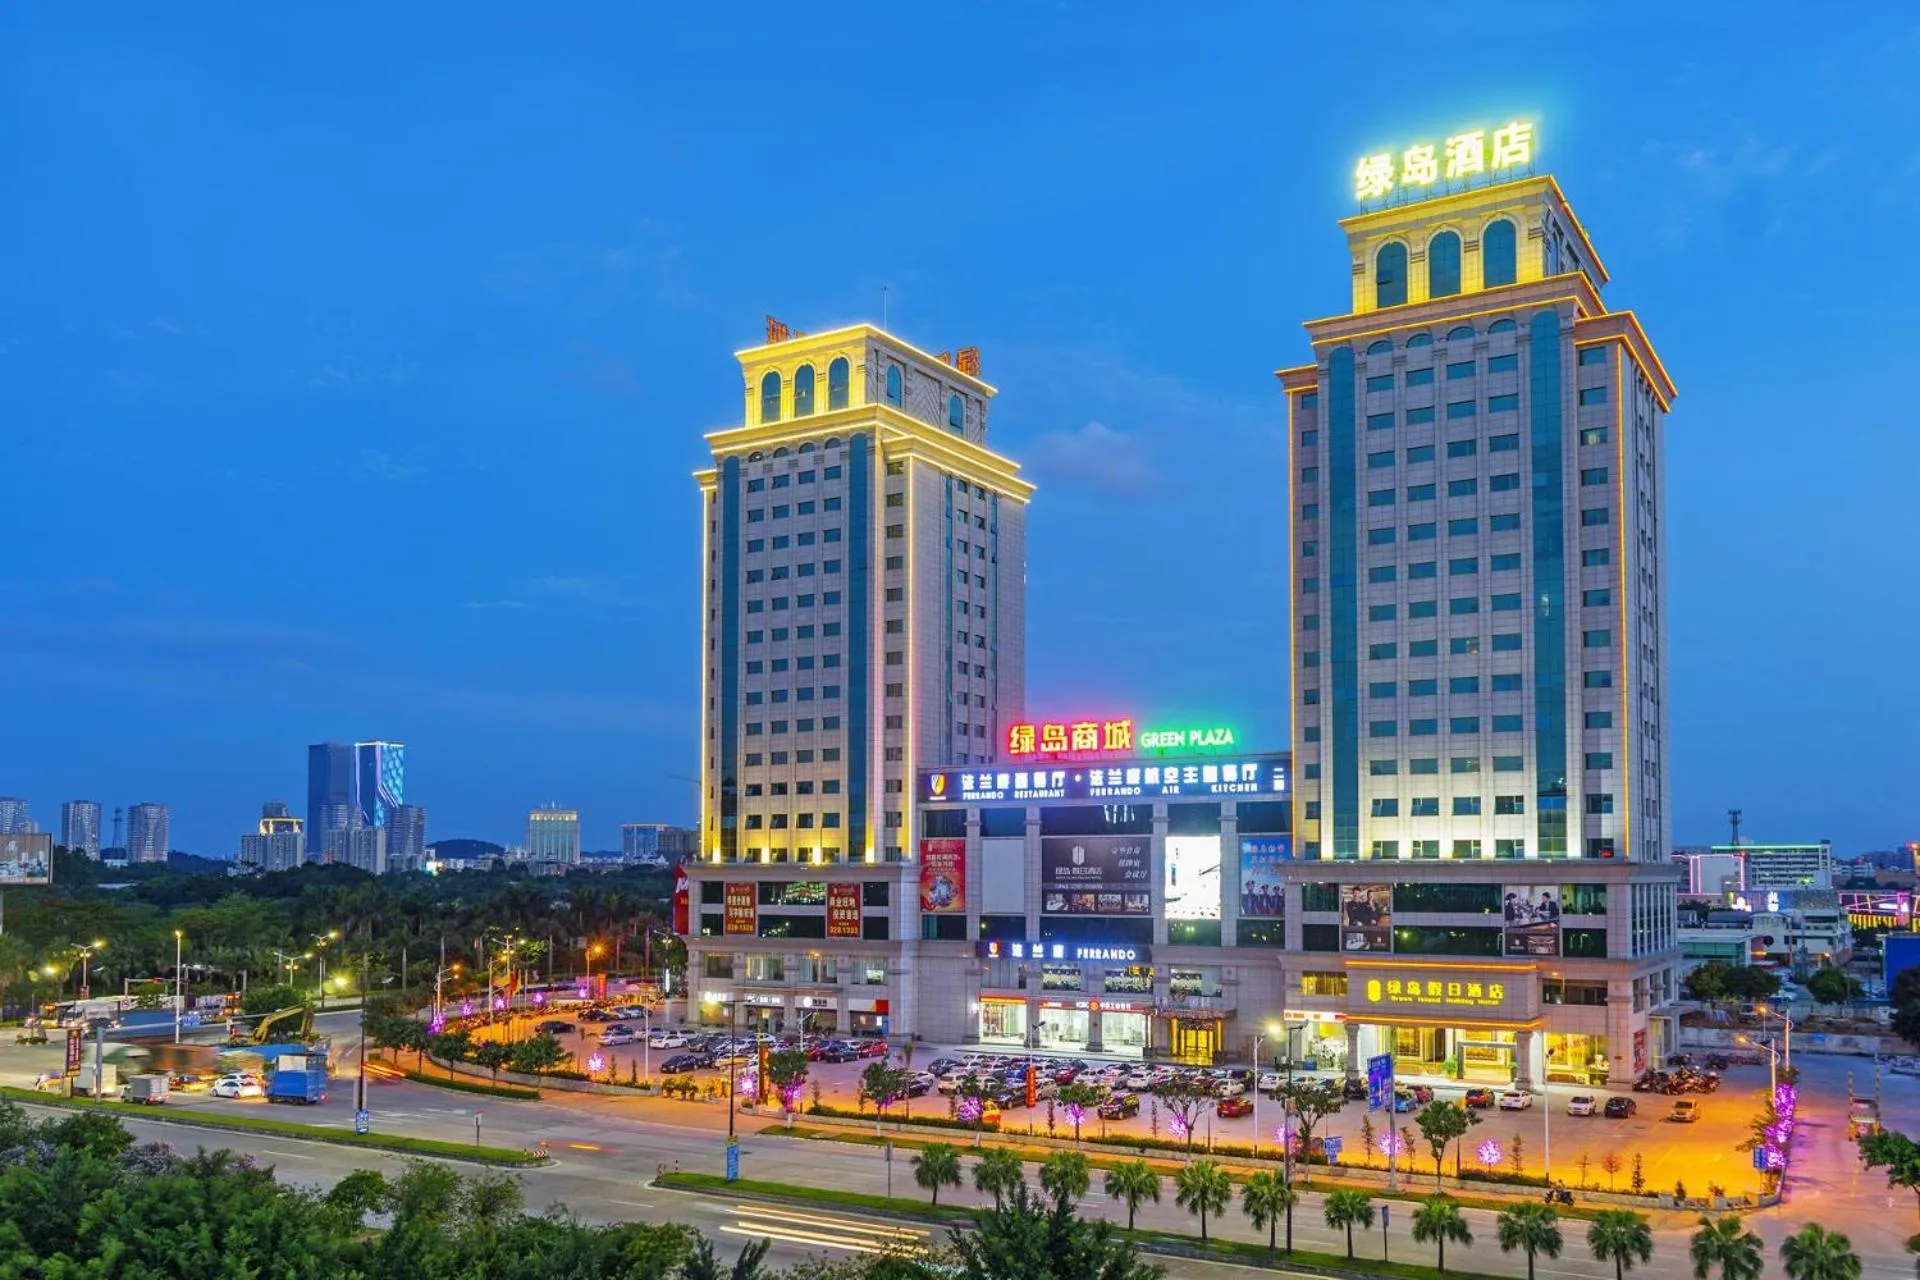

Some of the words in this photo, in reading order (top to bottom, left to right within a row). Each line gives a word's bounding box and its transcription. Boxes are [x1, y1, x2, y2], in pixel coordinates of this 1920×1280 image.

[1355, 122, 1533, 199] 绿岛酒店
[1008, 720, 1132, 754] 绿岛商城
[1140, 733, 1184, 748] GREEN
[1189, 728, 1233, 744] PLAZA
[1089, 786, 1142, 798] FERRANDO
[1161, 784, 1180, 795] AIR
[1210, 782, 1258, 794] KITCHEN
[1077, 948, 1137, 961] FERRANDO
[1386, 979, 1505, 1000] 绿岛假日酒店
